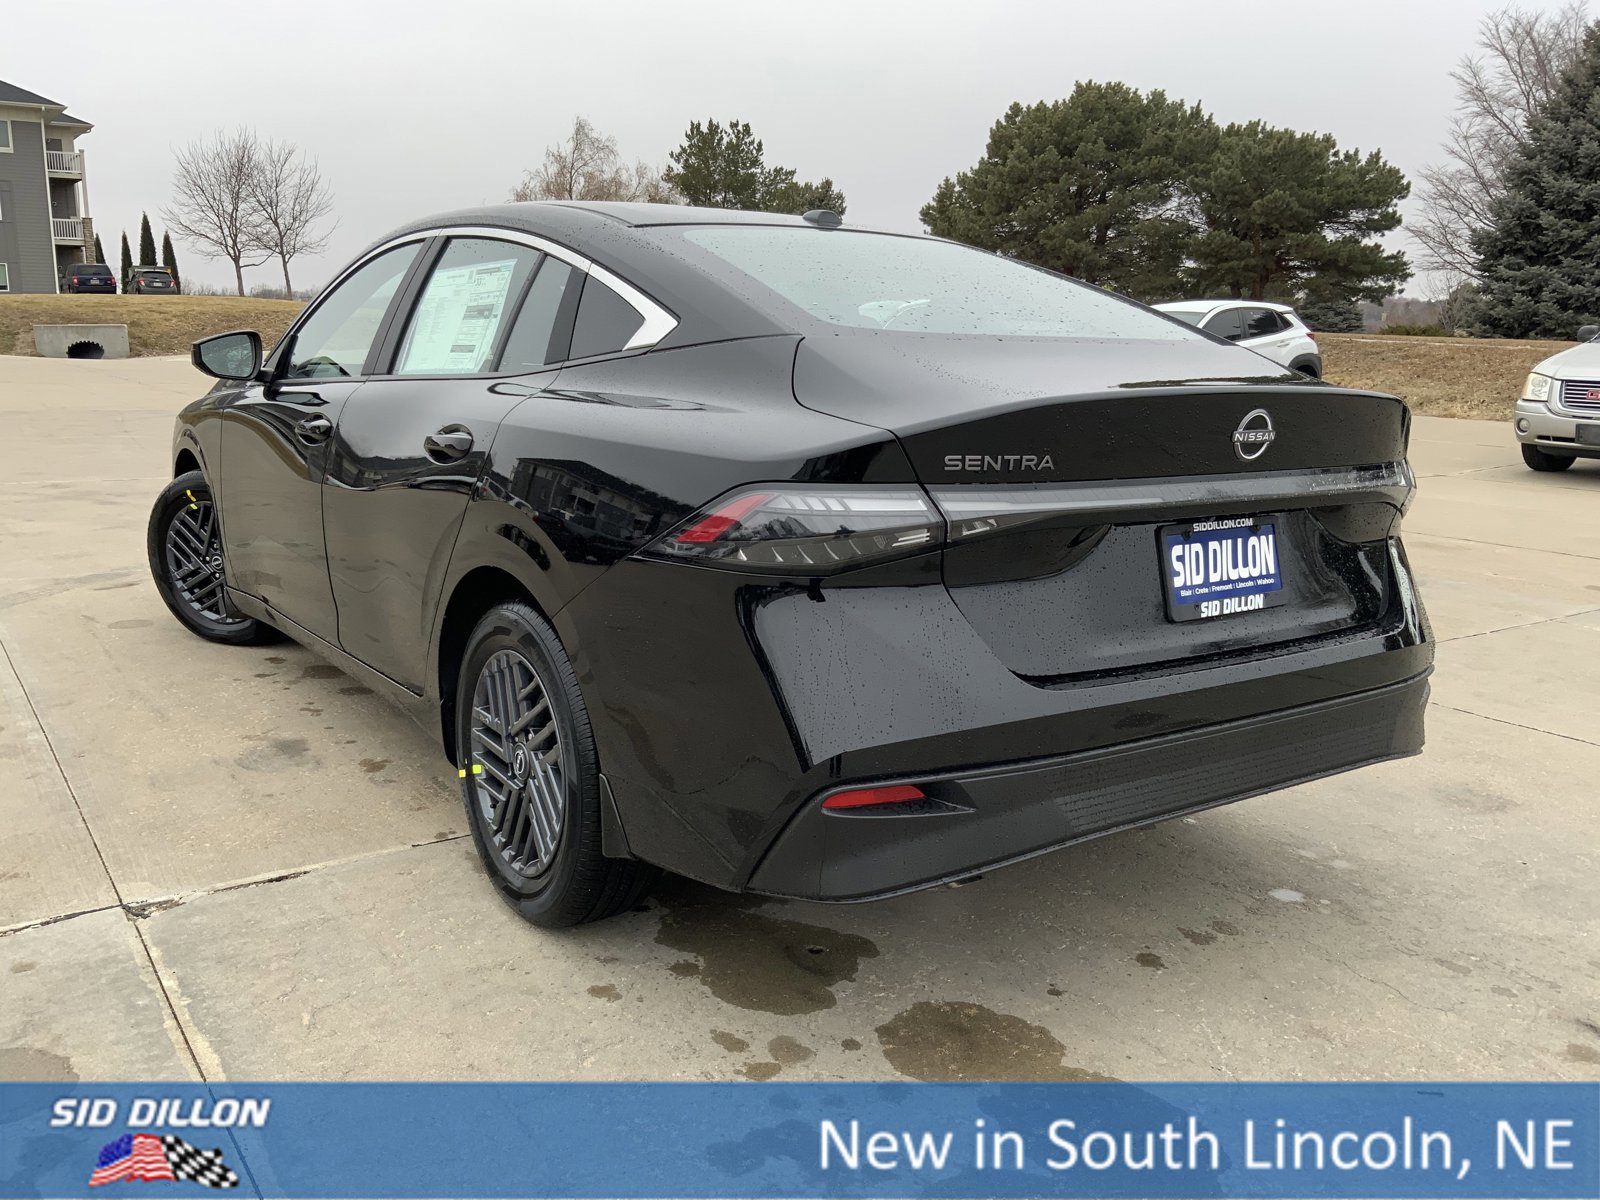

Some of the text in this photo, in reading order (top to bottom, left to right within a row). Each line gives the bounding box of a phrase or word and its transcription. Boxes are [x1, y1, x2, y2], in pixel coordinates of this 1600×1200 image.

[1234, 431, 1276, 442] NISSAN
[943, 454, 1056, 471] SENTRA
[1193, 518, 1253, 532] SIDDILLON.COM
[1171, 534, 1275, 588] SID DILLON
[1180, 578, 1275, 597] Blair Crete Fremont Lincoln Wahoo
[1200, 593, 1264, 618] SID DILLON
